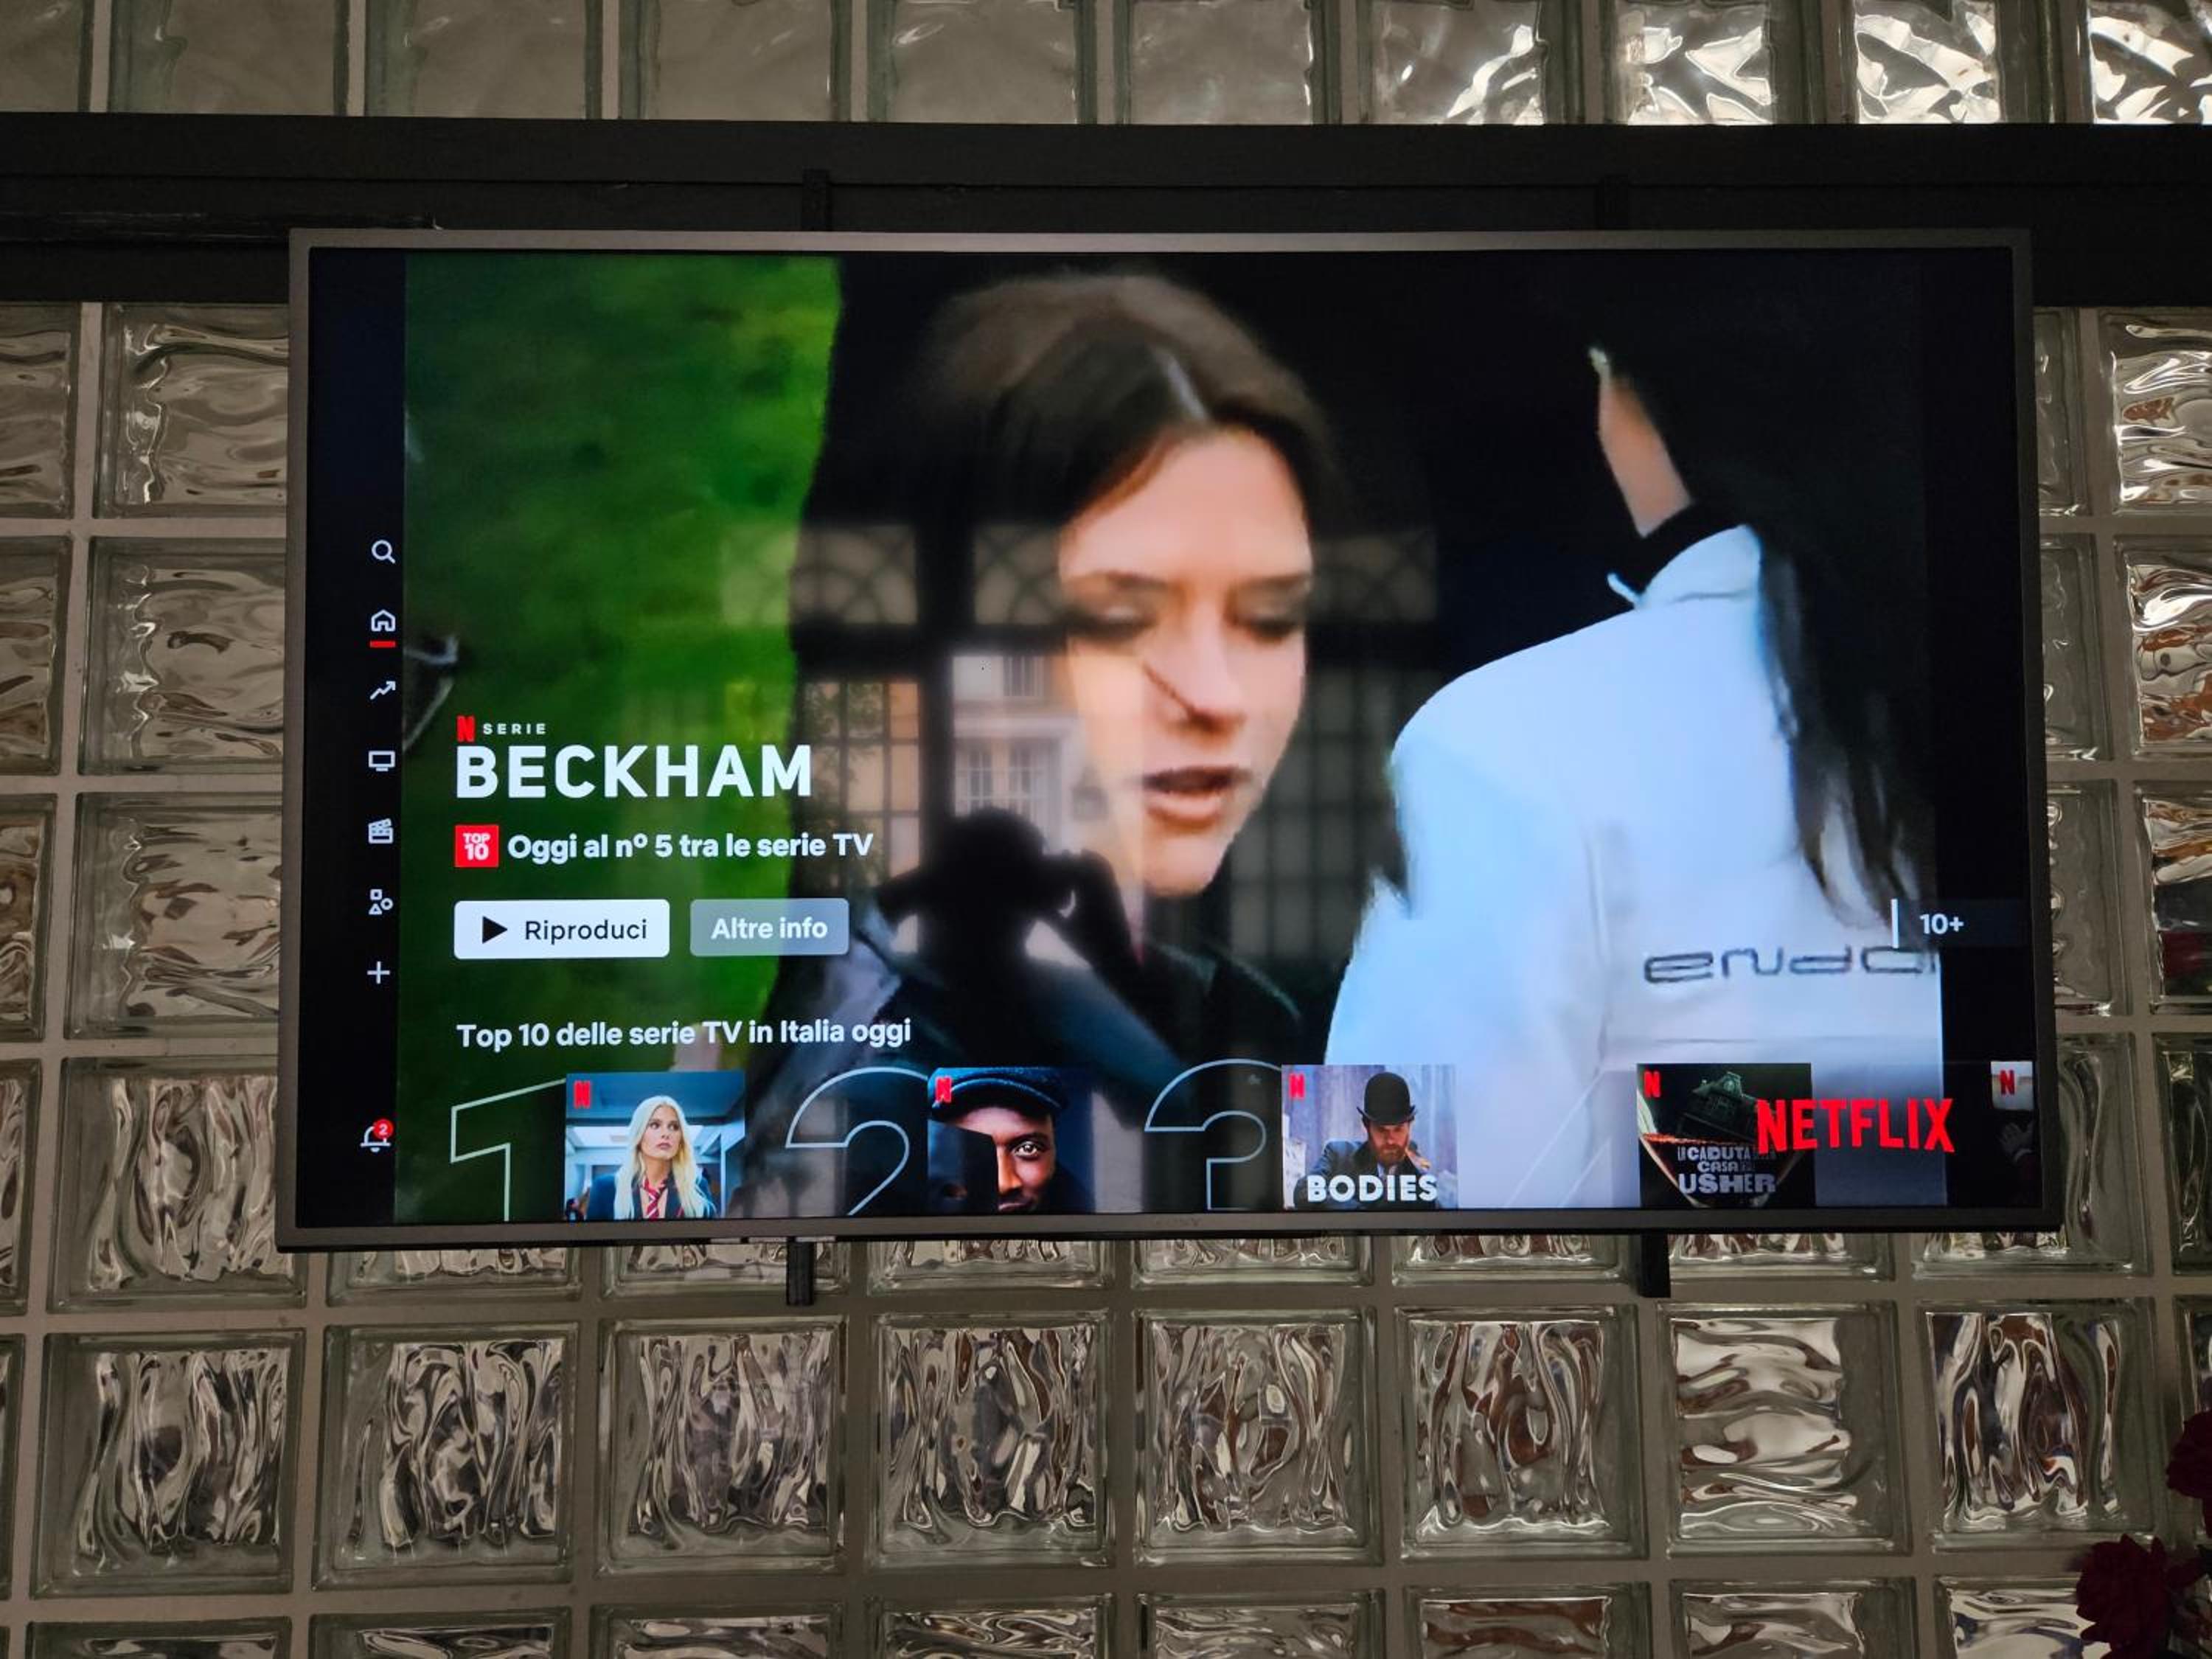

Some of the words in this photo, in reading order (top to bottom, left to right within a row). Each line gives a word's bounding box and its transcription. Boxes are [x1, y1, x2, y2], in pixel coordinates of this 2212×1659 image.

[456, 714, 476, 742] N
[482, 723, 547, 736] SERIE
[456, 744, 811, 799] BECKHAM
[462, 832, 491, 844] TOP
[507, 832, 577, 865] Oggi
[583, 834, 608, 858] al
[655, 834, 672, 858] 5
[678, 835, 720, 858] tra
[726, 832, 751, 858] le
[757, 832, 827, 858] serie
[832, 832, 874, 857] TV
[464, 844, 490, 861] 10
[524, 918, 647, 945] Riproduci
[710, 917, 773, 940] Altre
[779, 916, 828, 939] info
[1919, 913, 1964, 934] 10+
[456, 1023, 512, 1053] Top
[518, 1022, 550, 1046] 10
[555, 1021, 623, 1046] delle
[628, 1020, 696, 1046] serie
[702, 1020, 742, 1044] TV
[748, 1019, 773, 1043] in
[780, 1018, 845, 1043] Italia
[852, 1017, 911, 1048] oggi
[1755, 1098, 1955, 1155] NETFLIX
[1687, 1146, 1751, 1161] CADUTA
[1697, 1161, 1739, 1173] CASA
[1307, 1174, 1438, 1203] BODIES
[1678, 1172, 1776, 1194] USHER
